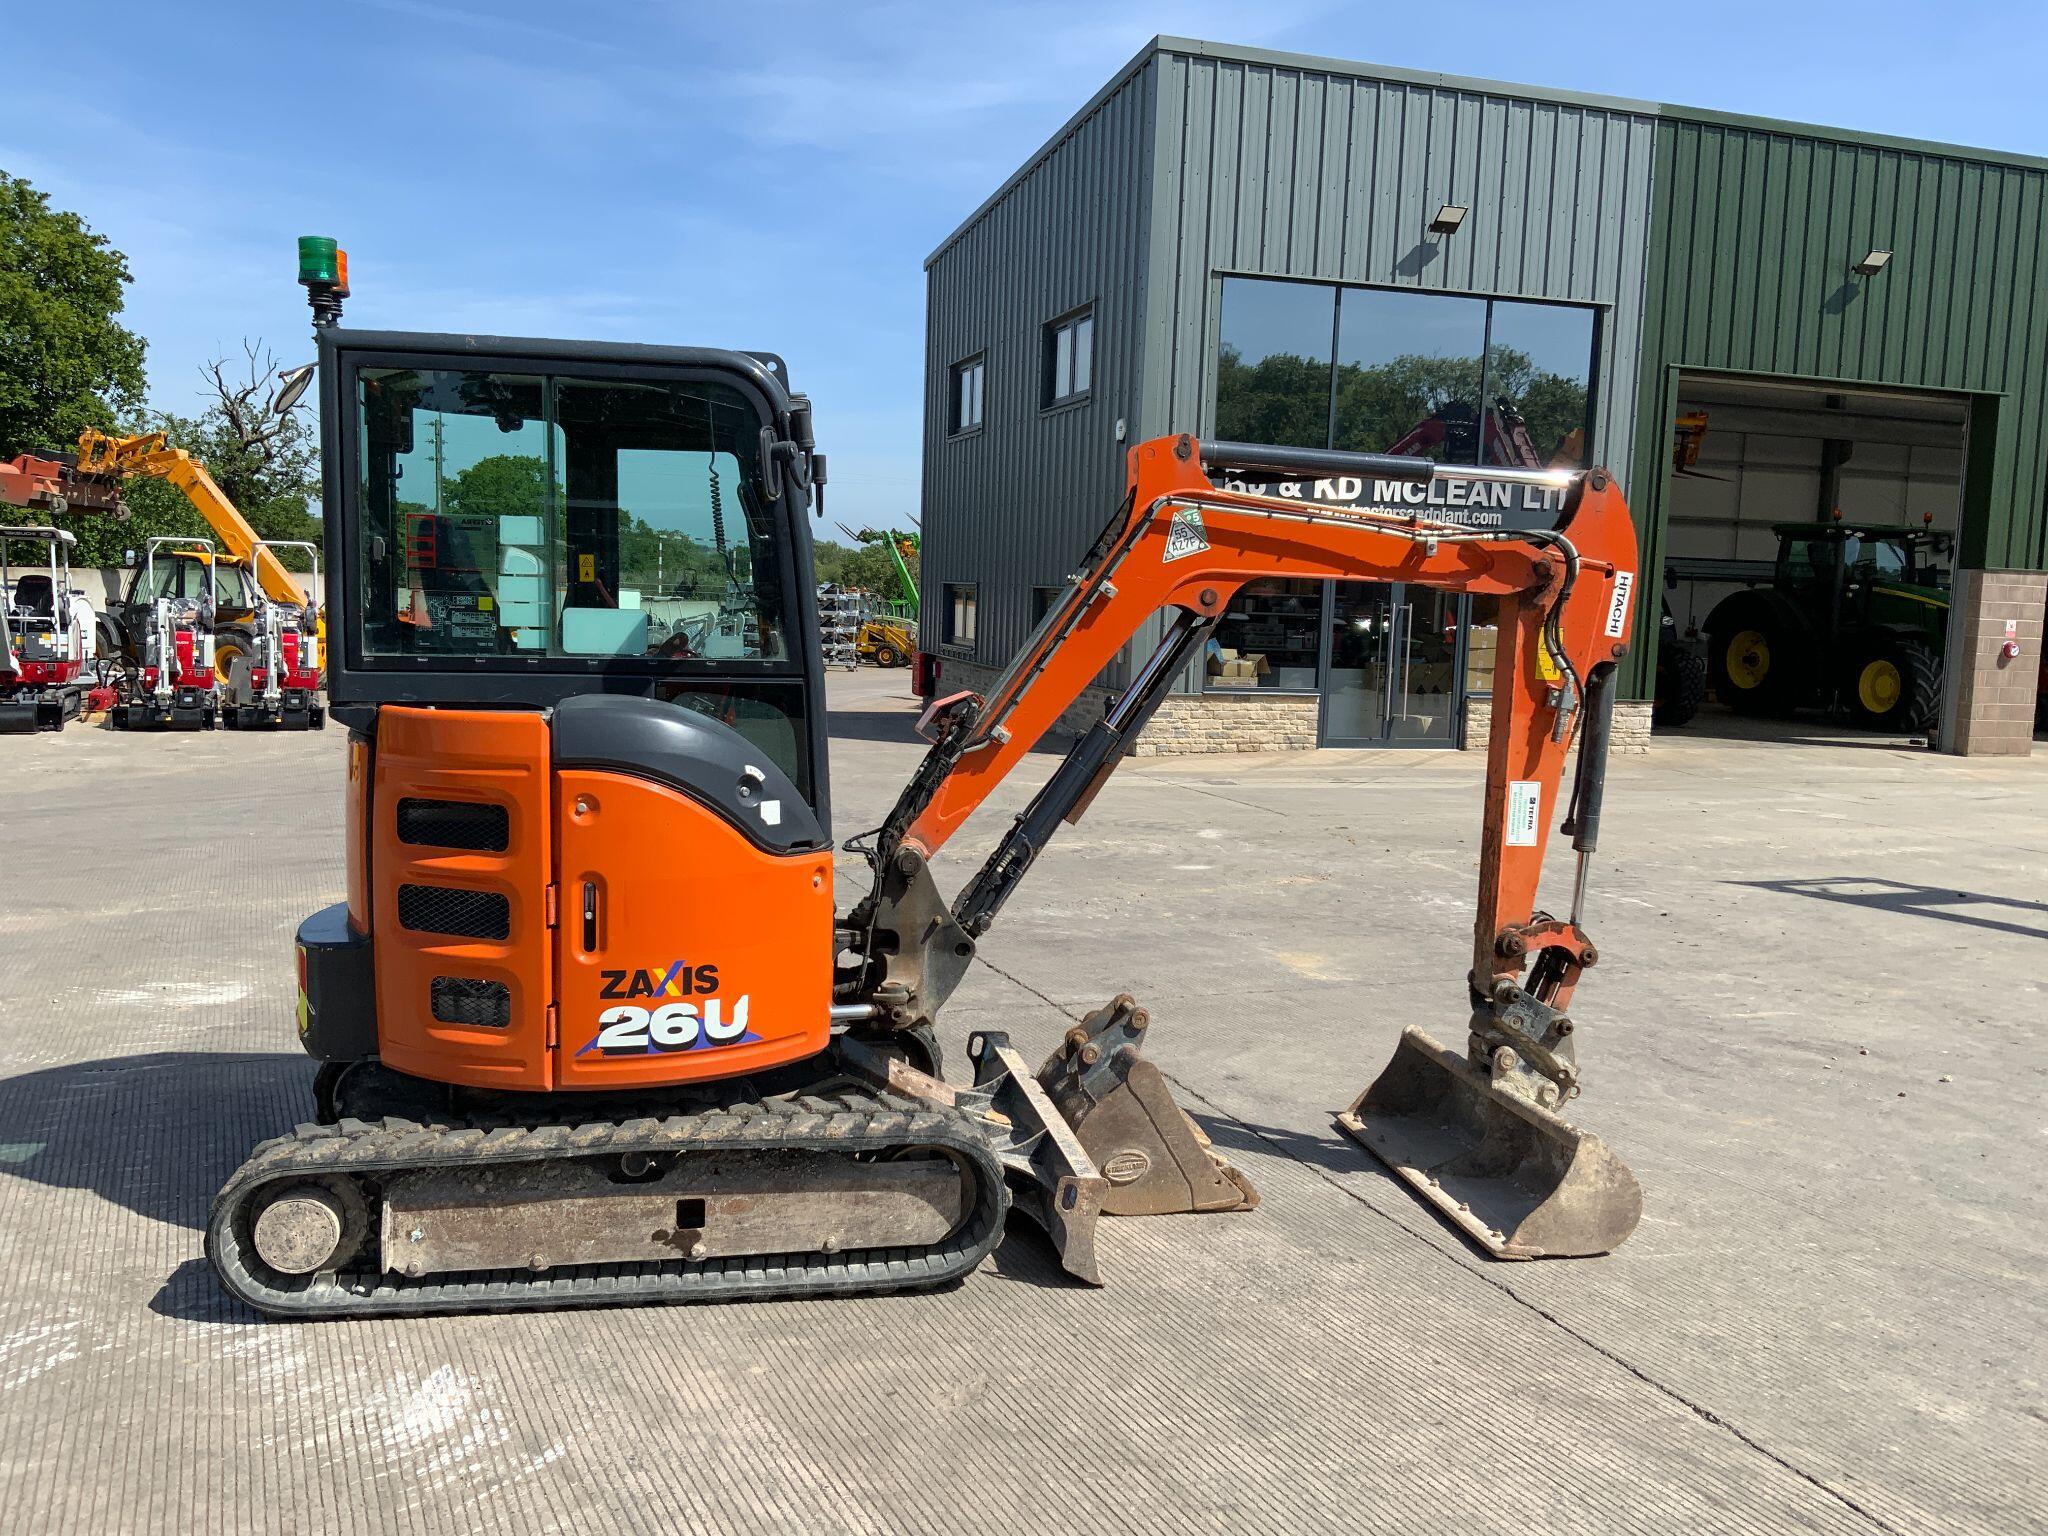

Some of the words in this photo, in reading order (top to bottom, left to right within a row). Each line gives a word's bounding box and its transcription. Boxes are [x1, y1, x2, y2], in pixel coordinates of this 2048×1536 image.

[1278, 482, 1303, 498] &
[1313, 477, 1363, 501] KD
[1373, 478, 1512, 508] MCLEAN
[1174, 527, 1188, 540] 55
[1609, 575, 1629, 633] HITACHI
[1527, 805, 1535, 831] TEFRA
[599, 959, 719, 1000] ZAXIS
[596, 994, 749, 1054] 26U
